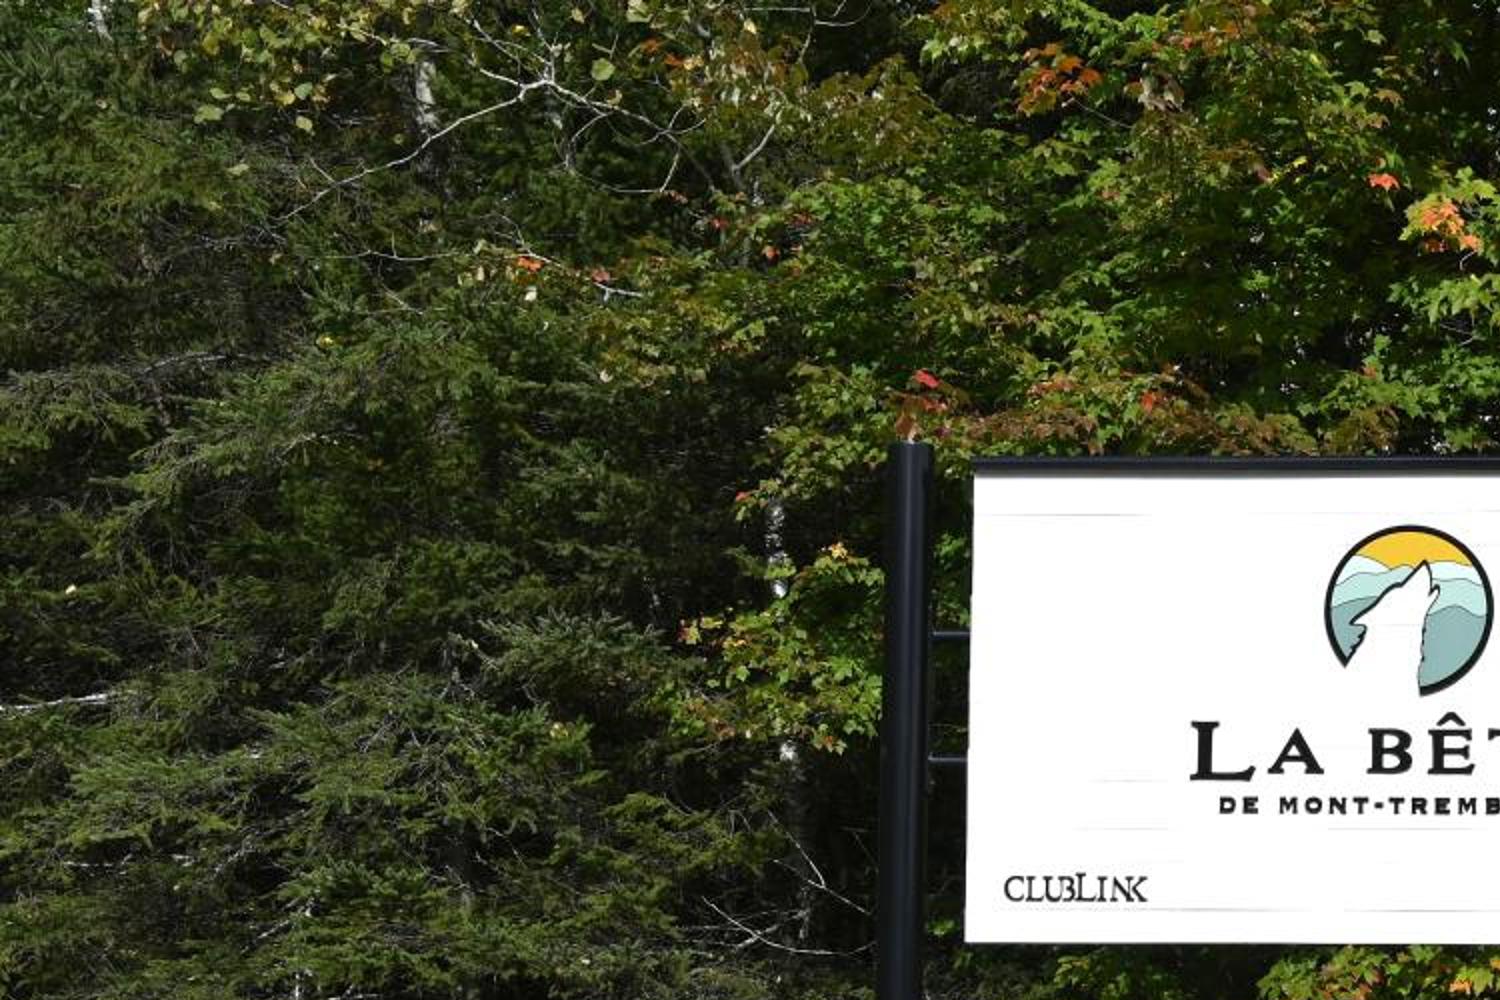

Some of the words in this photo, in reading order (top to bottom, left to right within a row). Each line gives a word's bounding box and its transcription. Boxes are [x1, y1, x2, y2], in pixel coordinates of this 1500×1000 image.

[1189, 720, 1325, 782] LA
[1219, 796, 1259, 815] DE
[1003, 872, 1149, 903] CLUBLINK
